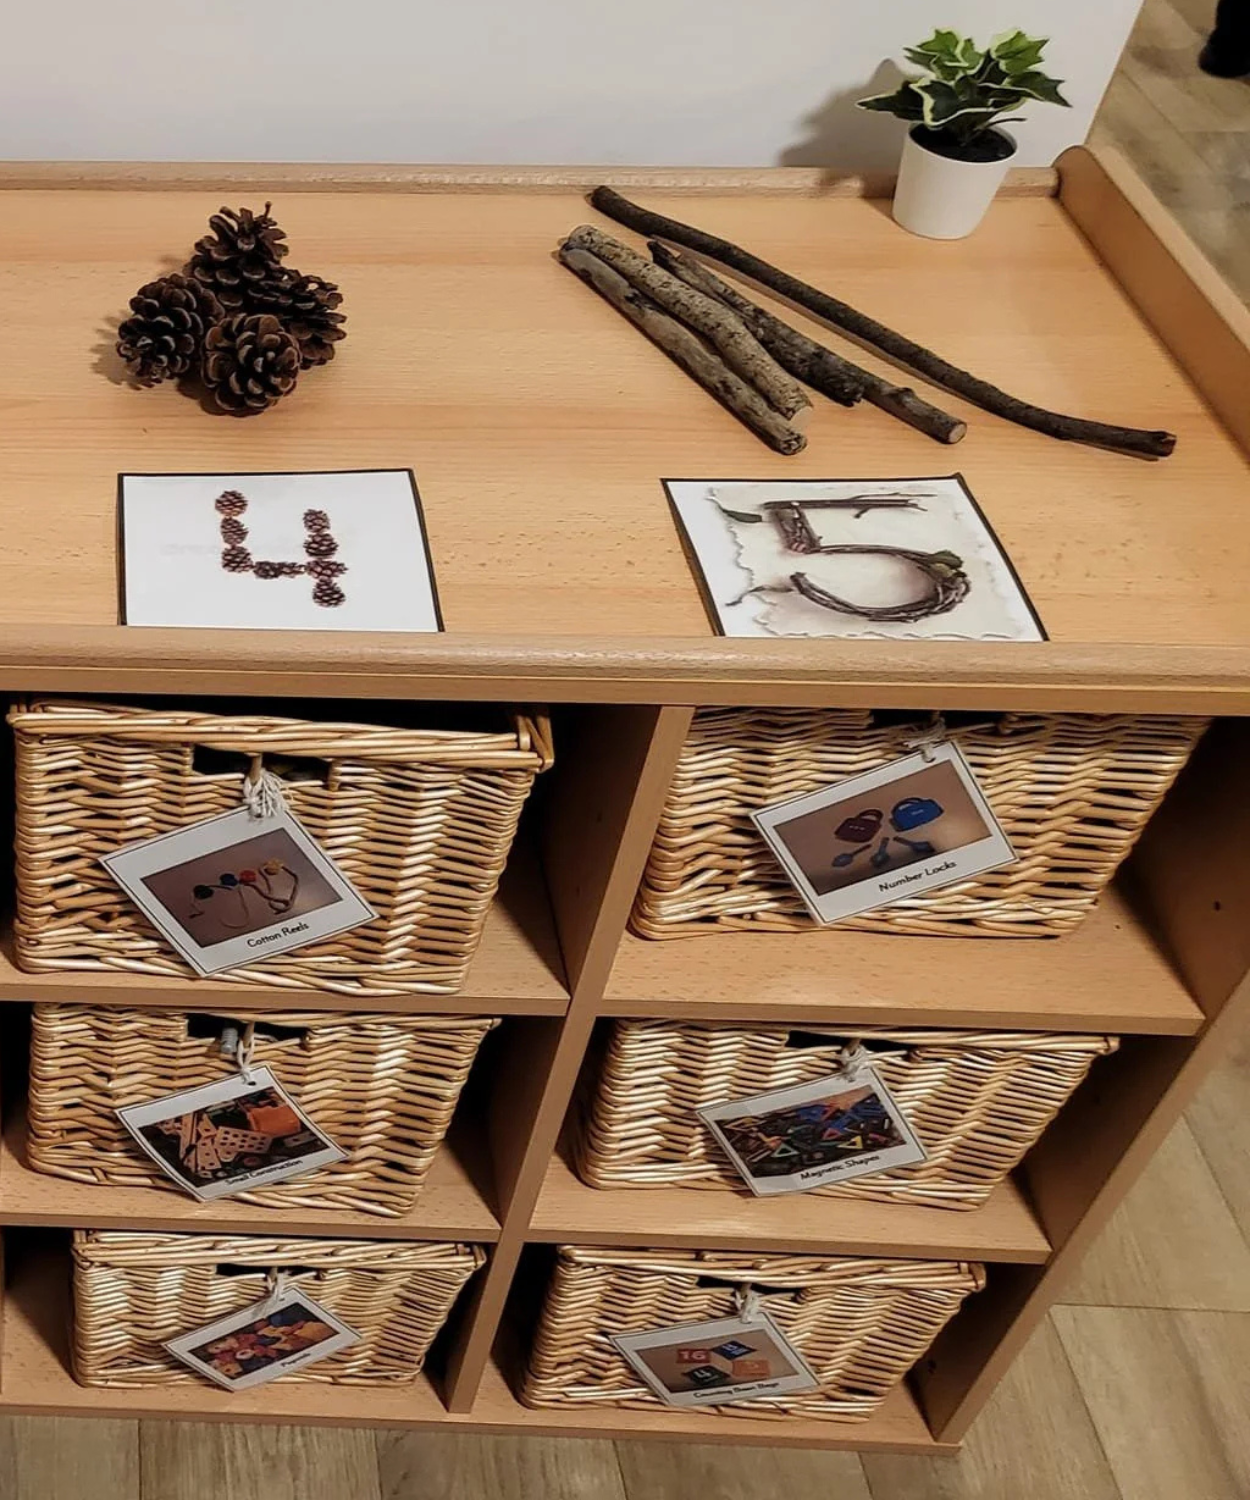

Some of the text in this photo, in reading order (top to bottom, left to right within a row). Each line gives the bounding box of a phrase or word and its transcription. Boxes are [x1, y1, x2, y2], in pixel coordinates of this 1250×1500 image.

[214, 489, 349, 609] 4
[762, 492, 972, 623] 5
[878, 860, 958, 893] Number Locks
[246, 922, 310, 948] Cotton Reels
[800, 1153, 881, 1182] Magnetic Shapes
